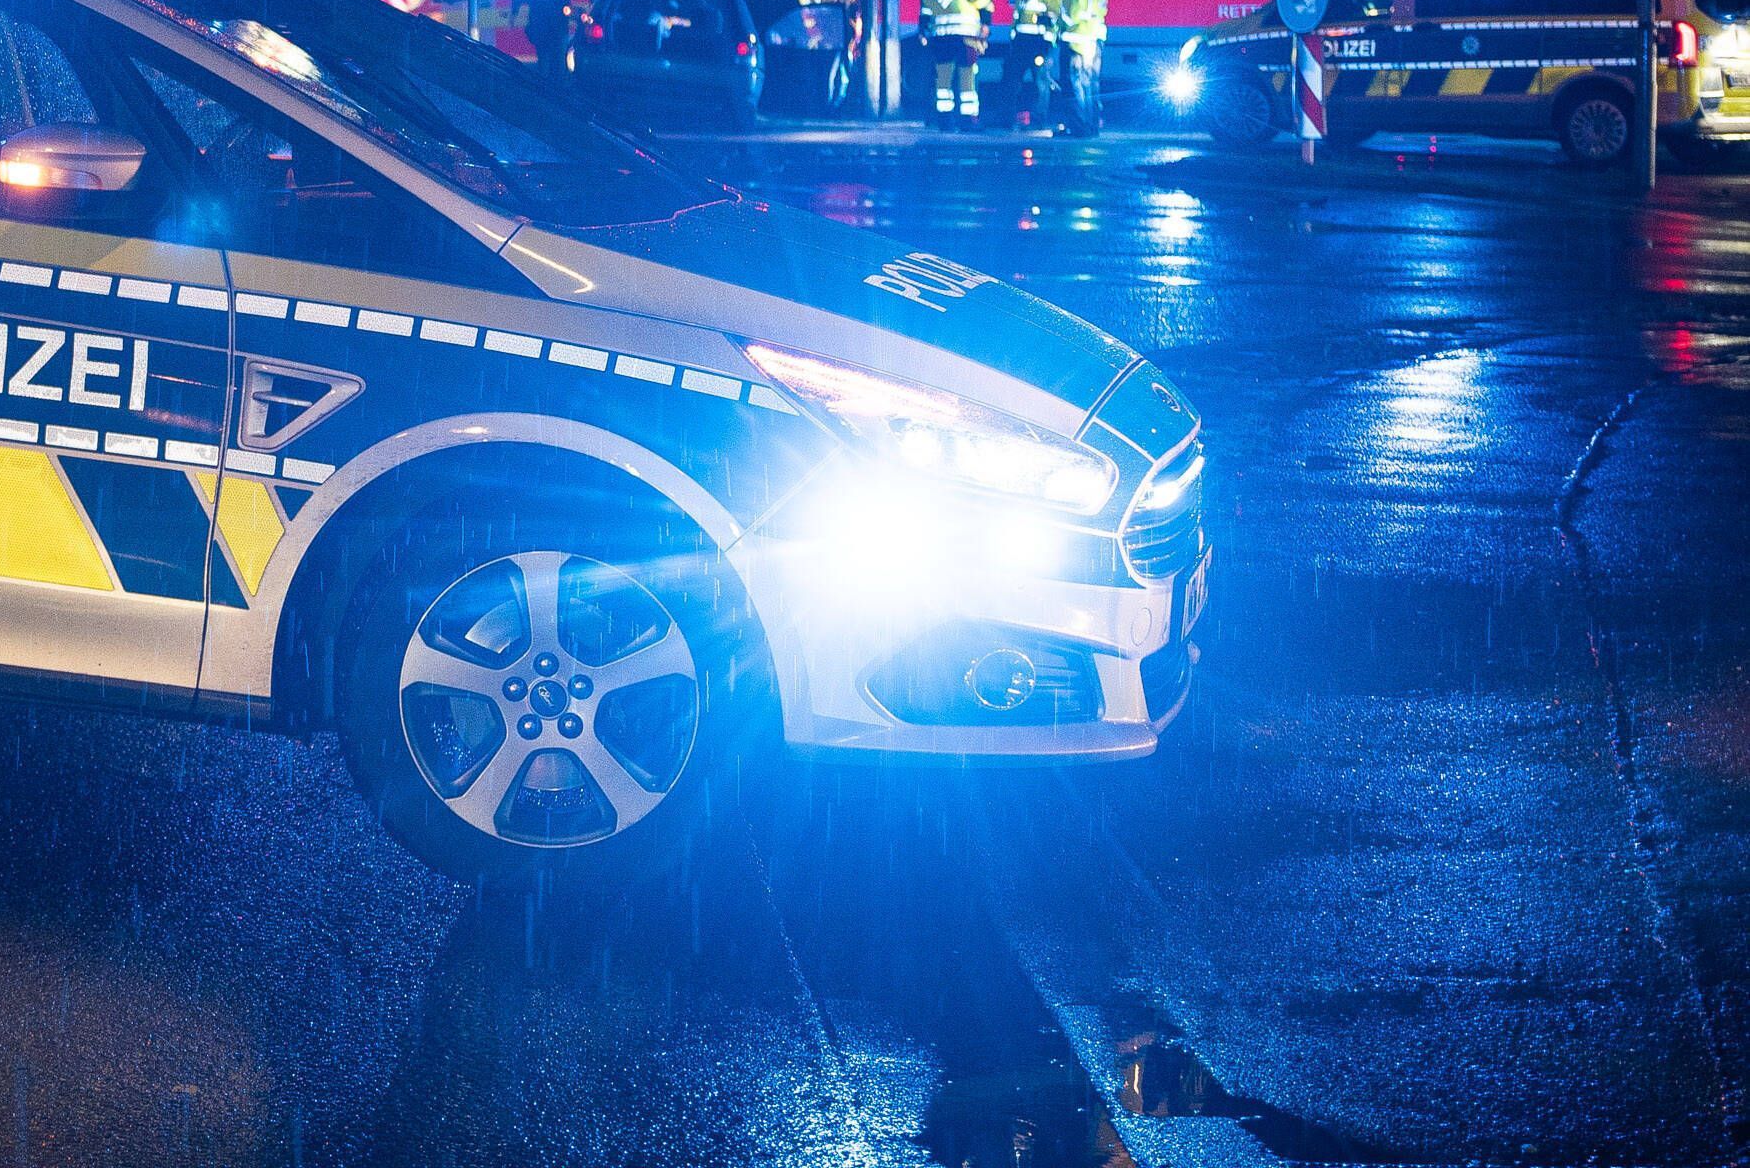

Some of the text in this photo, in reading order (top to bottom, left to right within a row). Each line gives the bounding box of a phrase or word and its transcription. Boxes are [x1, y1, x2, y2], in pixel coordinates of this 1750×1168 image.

[1217, 4, 1262, 19] RETT
[1323, 39, 1376, 58] OLIZEI
[863, 250, 1001, 313] POLIZ
